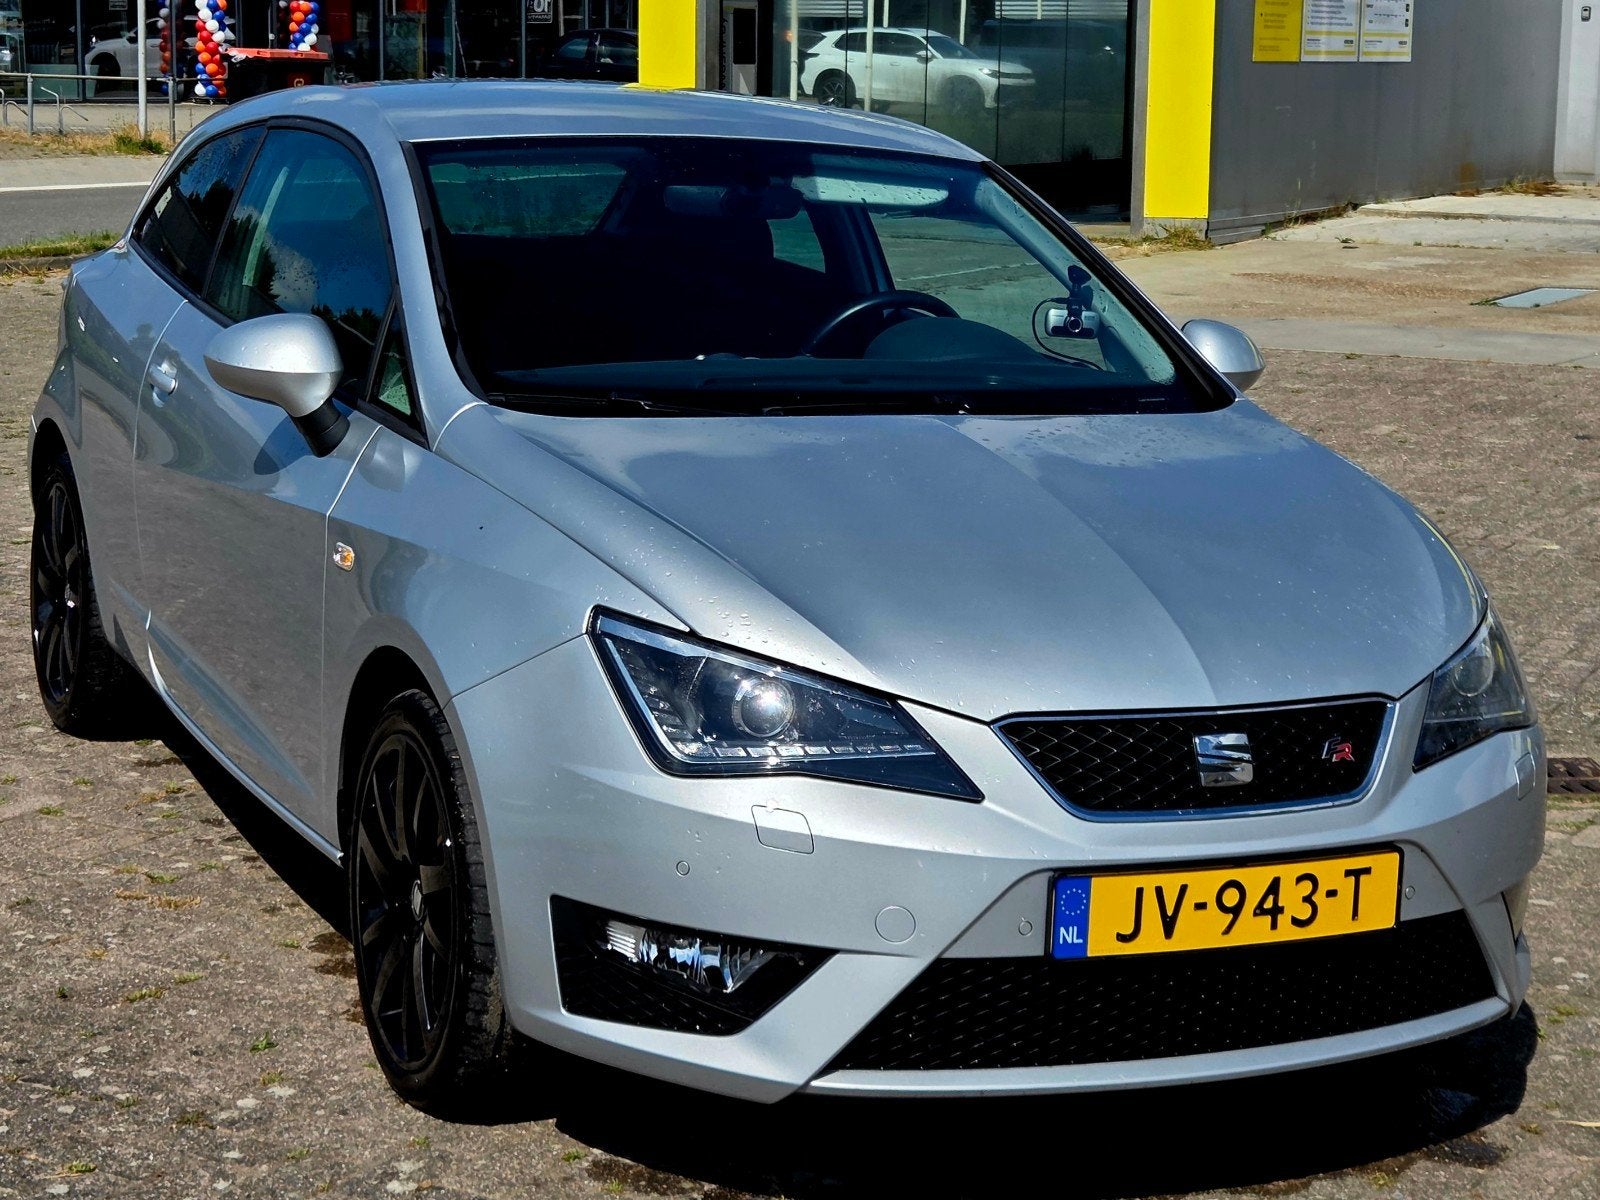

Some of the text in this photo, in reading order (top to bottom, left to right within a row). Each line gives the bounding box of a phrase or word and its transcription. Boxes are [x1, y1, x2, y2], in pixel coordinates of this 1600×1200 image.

[1321, 736, 1355, 762] FR
[1115, 866, 1372, 944] JV-943-T
[1059, 926, 1083, 944] NL
